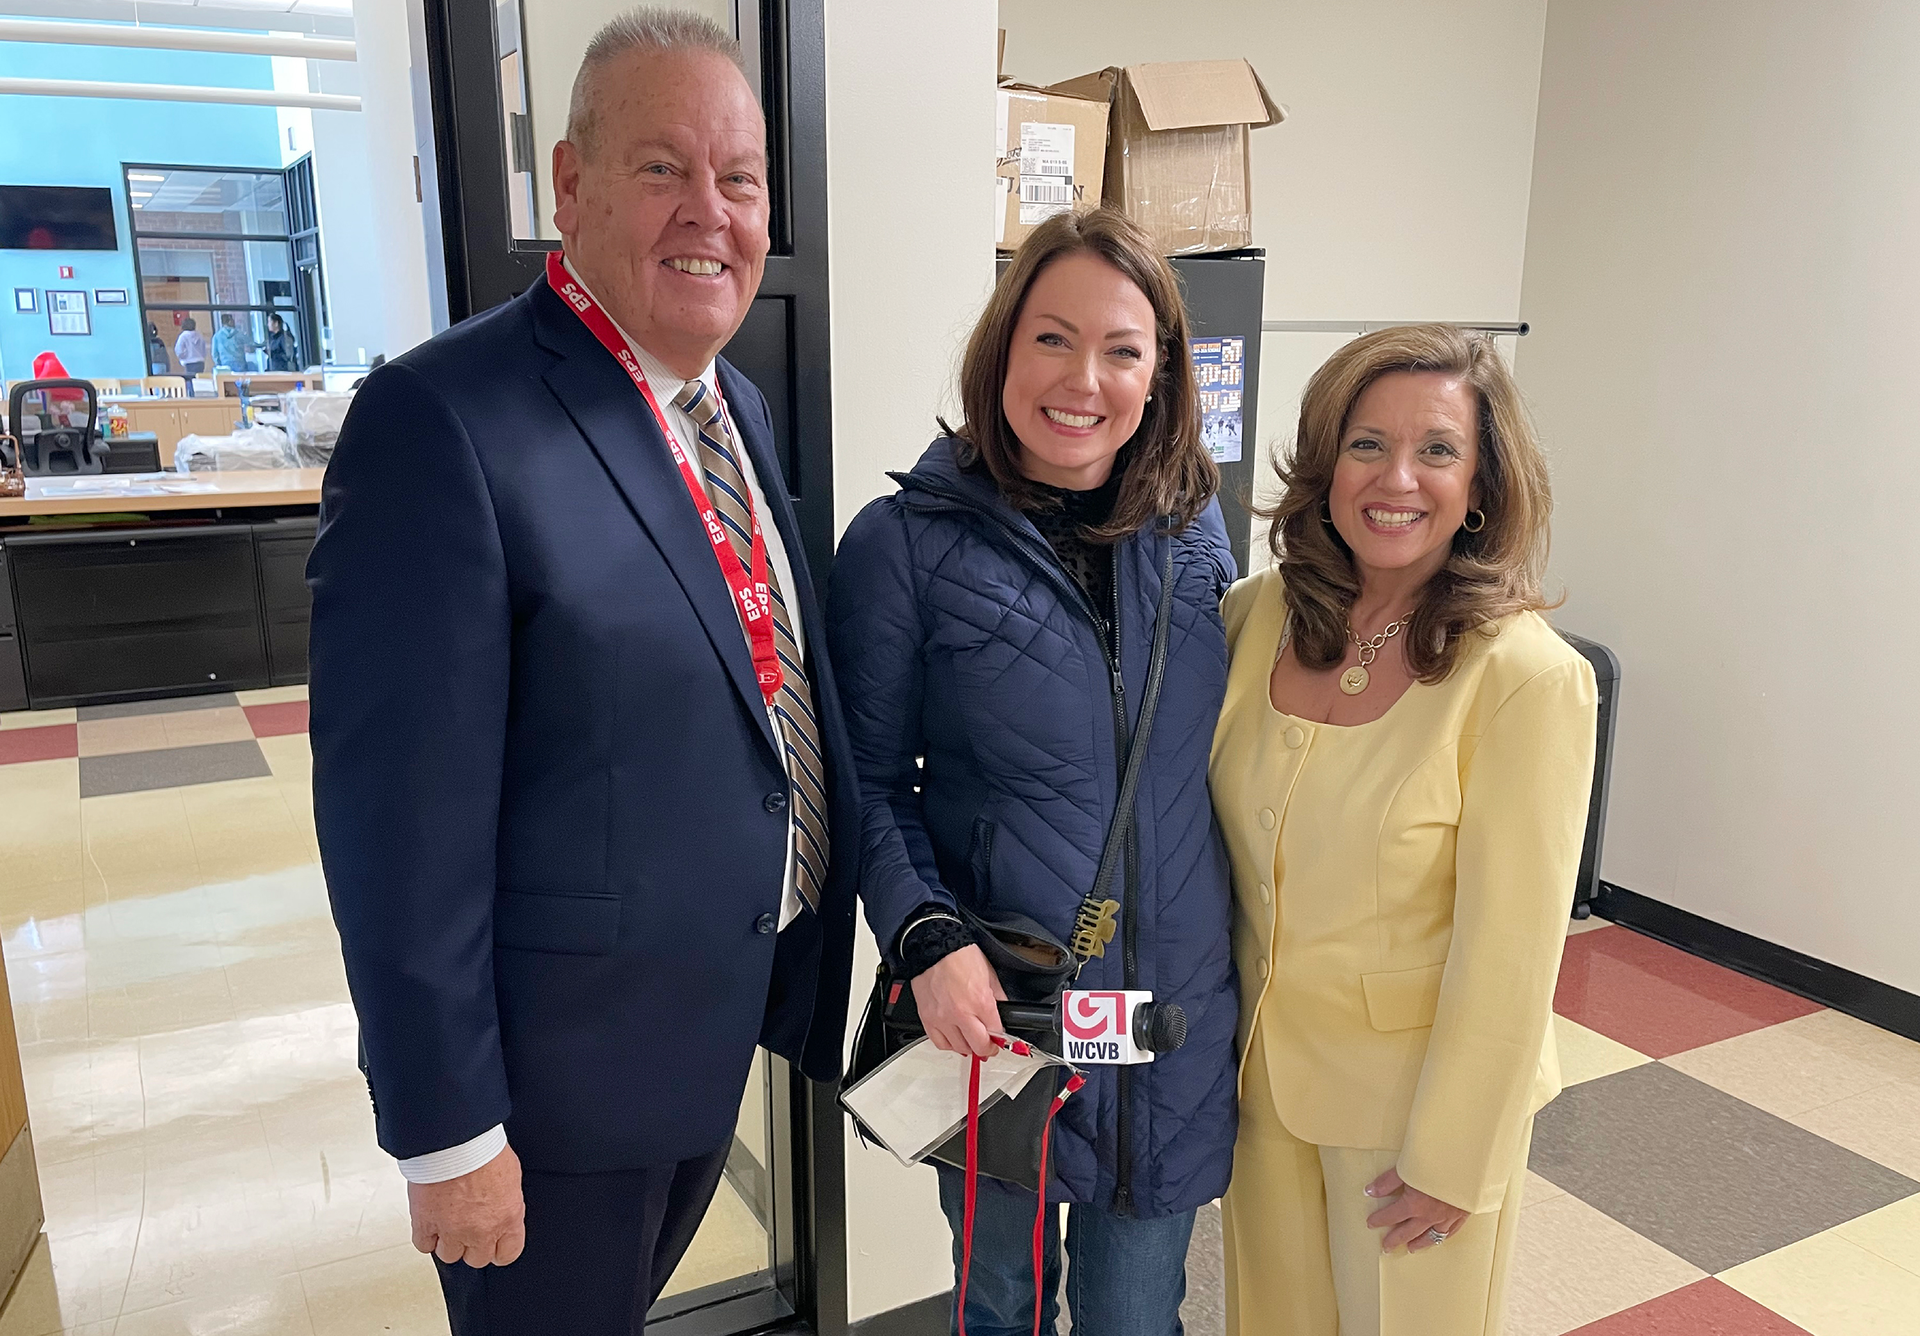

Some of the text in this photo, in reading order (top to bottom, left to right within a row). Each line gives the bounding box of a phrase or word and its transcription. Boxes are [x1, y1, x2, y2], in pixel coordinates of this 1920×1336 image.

[561, 283, 592, 312] EPS
[617, 349, 645, 382] EPS
[665, 429, 686, 465] EPS
[703, 509, 726, 545] EPS
[739, 587, 761, 622] EPS
[1068, 1041, 1120, 1060] WCVB
